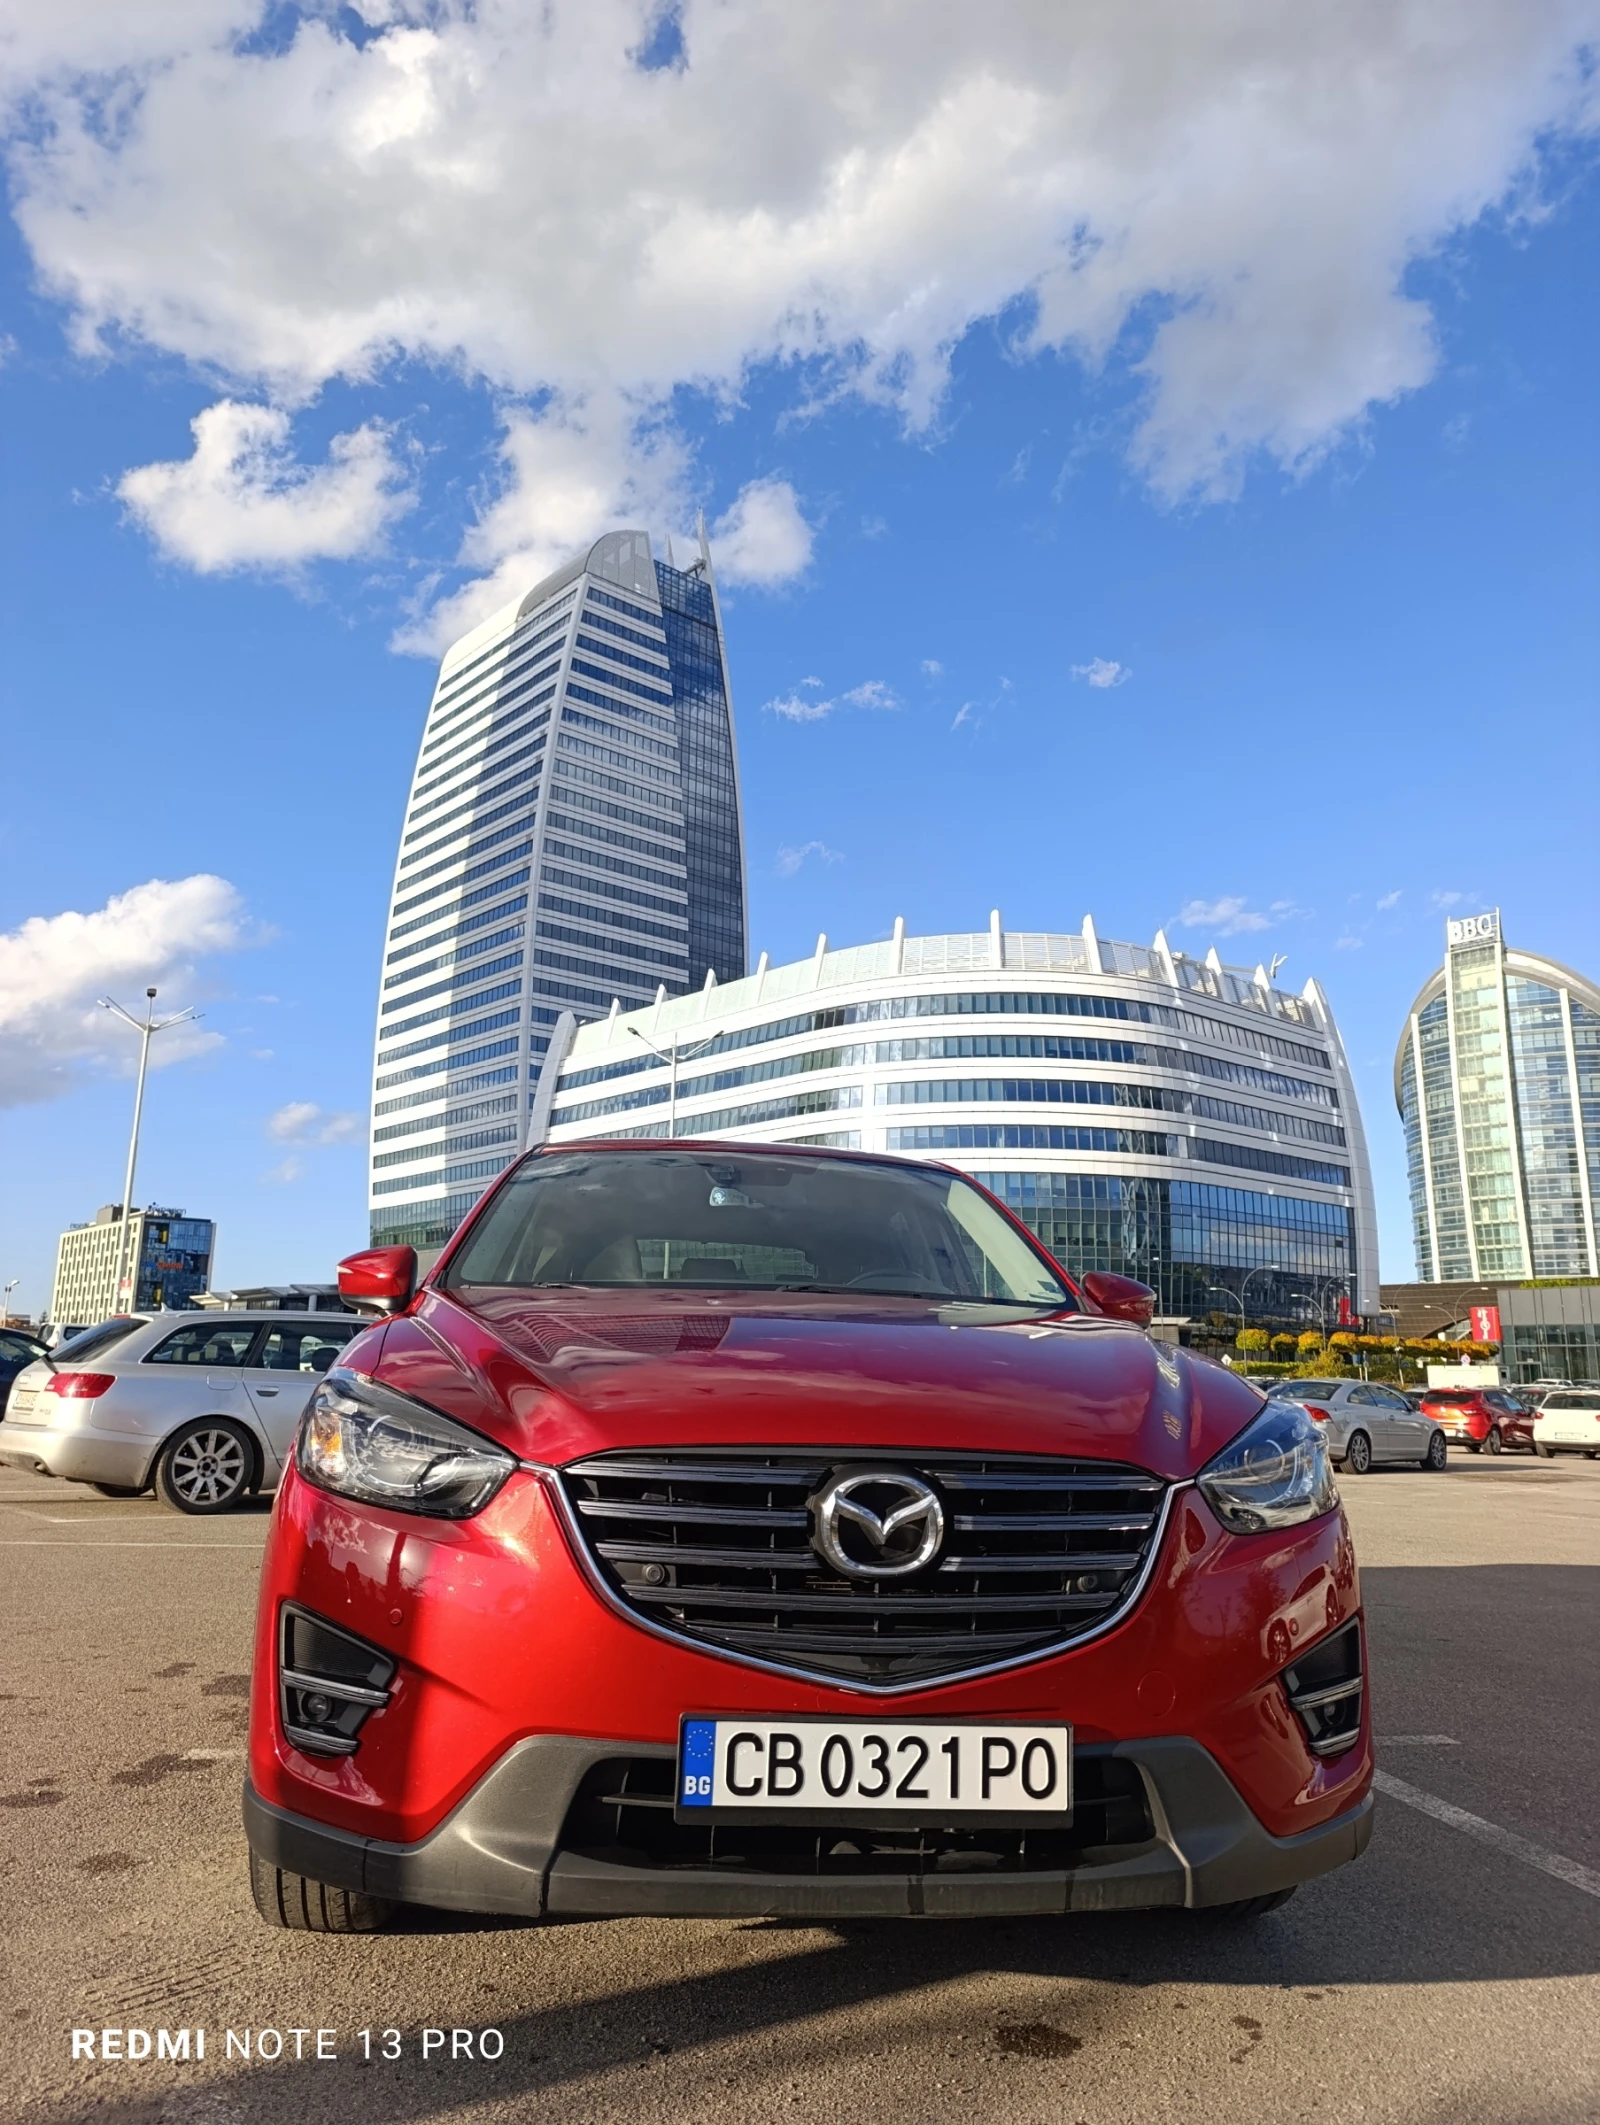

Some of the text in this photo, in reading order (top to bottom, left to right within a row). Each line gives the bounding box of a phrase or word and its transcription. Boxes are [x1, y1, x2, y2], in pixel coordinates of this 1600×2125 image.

[684, 1775, 711, 1796] BG
[725, 1732, 804, 1797] CB
[820, 1734, 959, 1799] 0321
